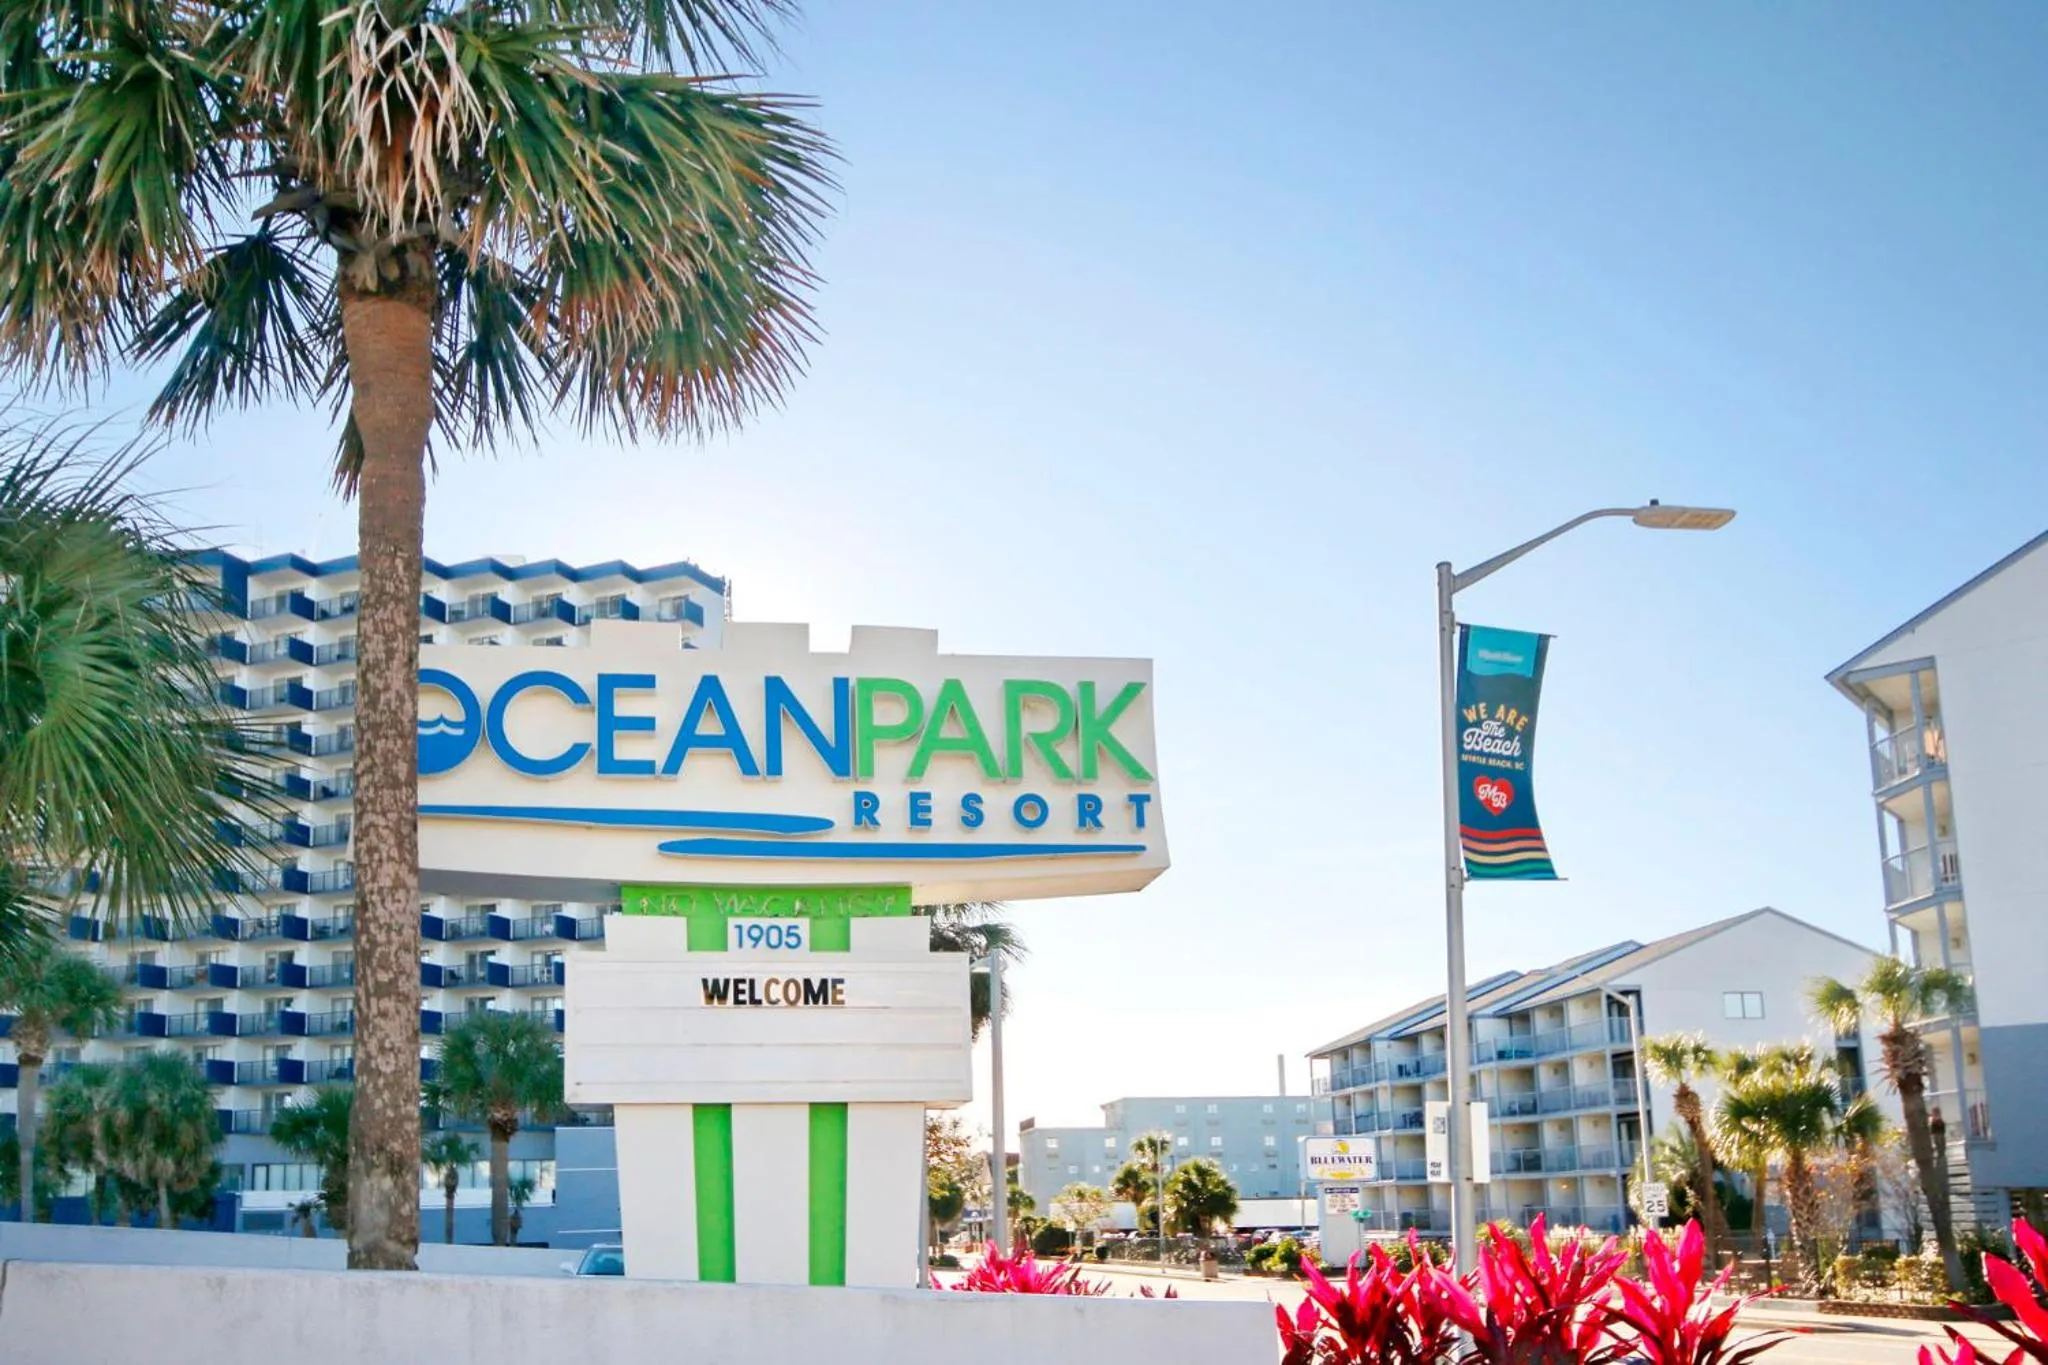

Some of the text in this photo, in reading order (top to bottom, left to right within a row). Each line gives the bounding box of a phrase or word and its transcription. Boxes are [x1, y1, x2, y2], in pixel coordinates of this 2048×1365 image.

[1463, 702, 1529, 732] WE ARE
[1482, 720, 1506, 738] The
[1463, 728, 1521, 757] Beach
[1478, 783, 1507, 809] MB
[852, 790, 1151, 829] RESORT
[733, 924, 802, 950] 1905
[701, 977, 845, 1006] WELCOME
[1310, 1155, 1373, 1165] BLUEWATER
[1646, 1200, 1665, 1213] 25
